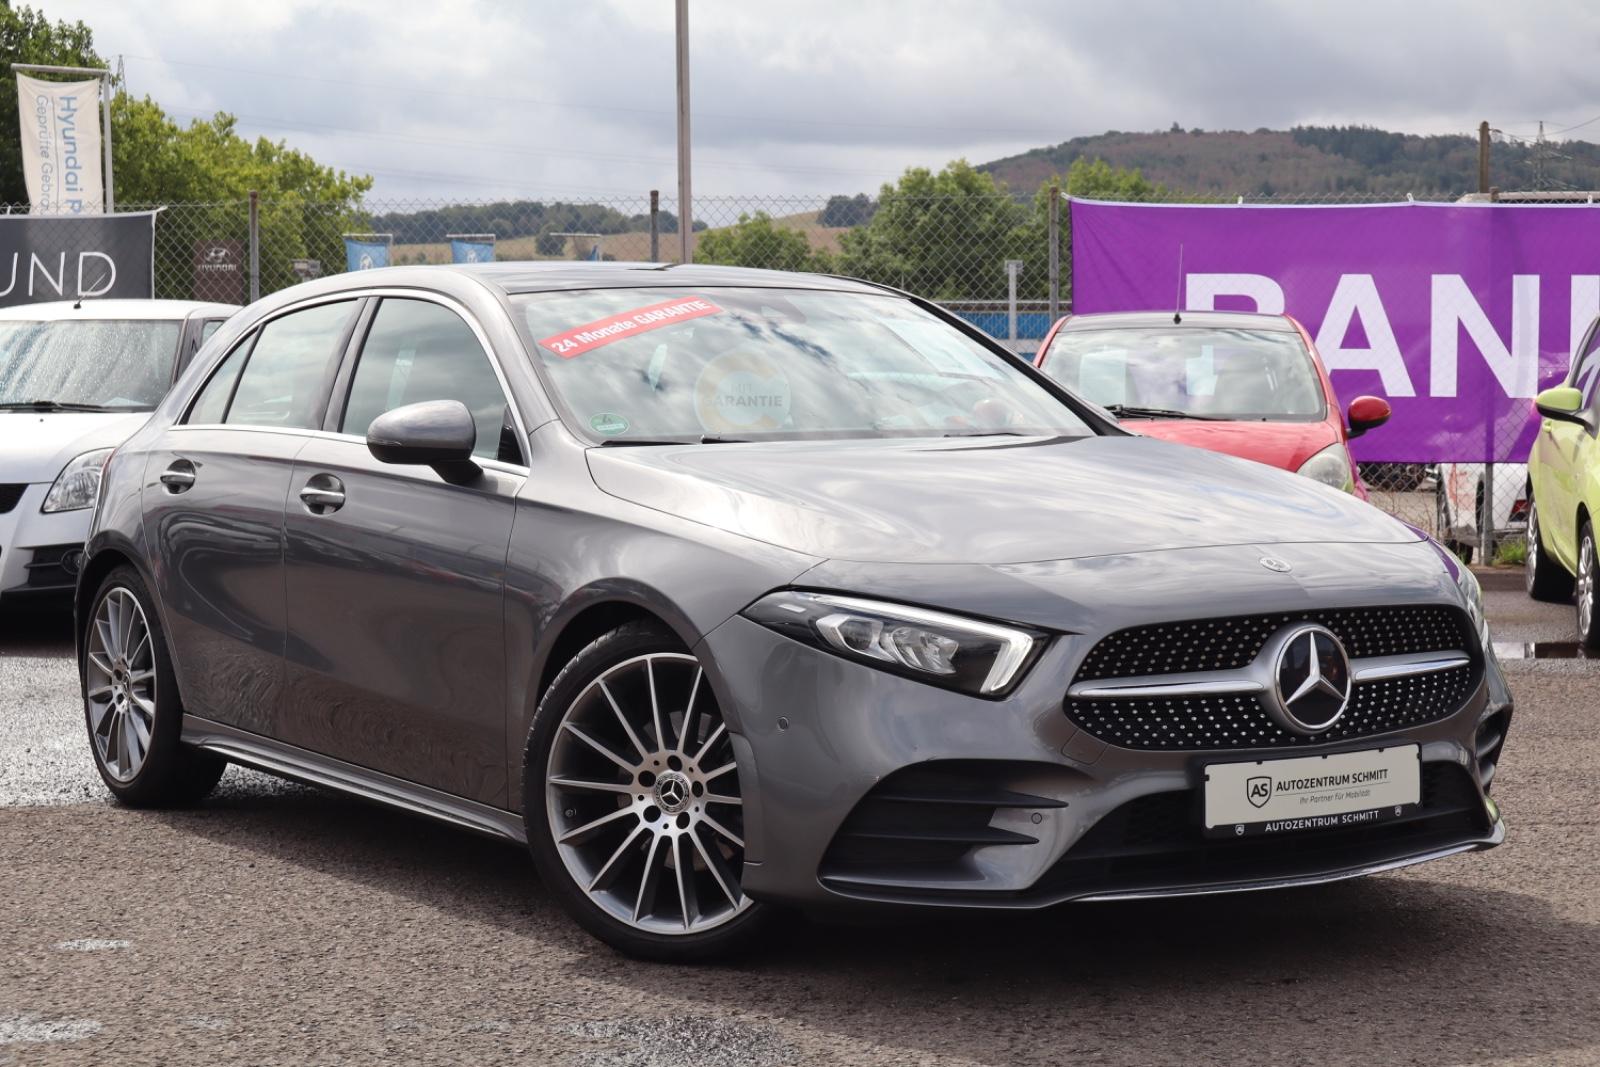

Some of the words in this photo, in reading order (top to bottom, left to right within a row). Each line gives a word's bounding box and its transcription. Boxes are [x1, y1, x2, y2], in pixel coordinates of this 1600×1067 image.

[57, 96, 83, 191] Hyundai
[40, 162, 53, 214] Gebra
[551, 338, 577, 353] 24
[574, 319, 638, 343] Monate
[633, 299, 712, 325] GARANTIE
[1250, 783, 1269, 798] AS
[1276, 774, 1350, 791] AUTOZENTRUM
[1352, 769, 1388, 784] SCHMITT
[1265, 816, 1338, 832] AUTOZENTRUM
[1342, 810, 1379, 824] SCHMITT
